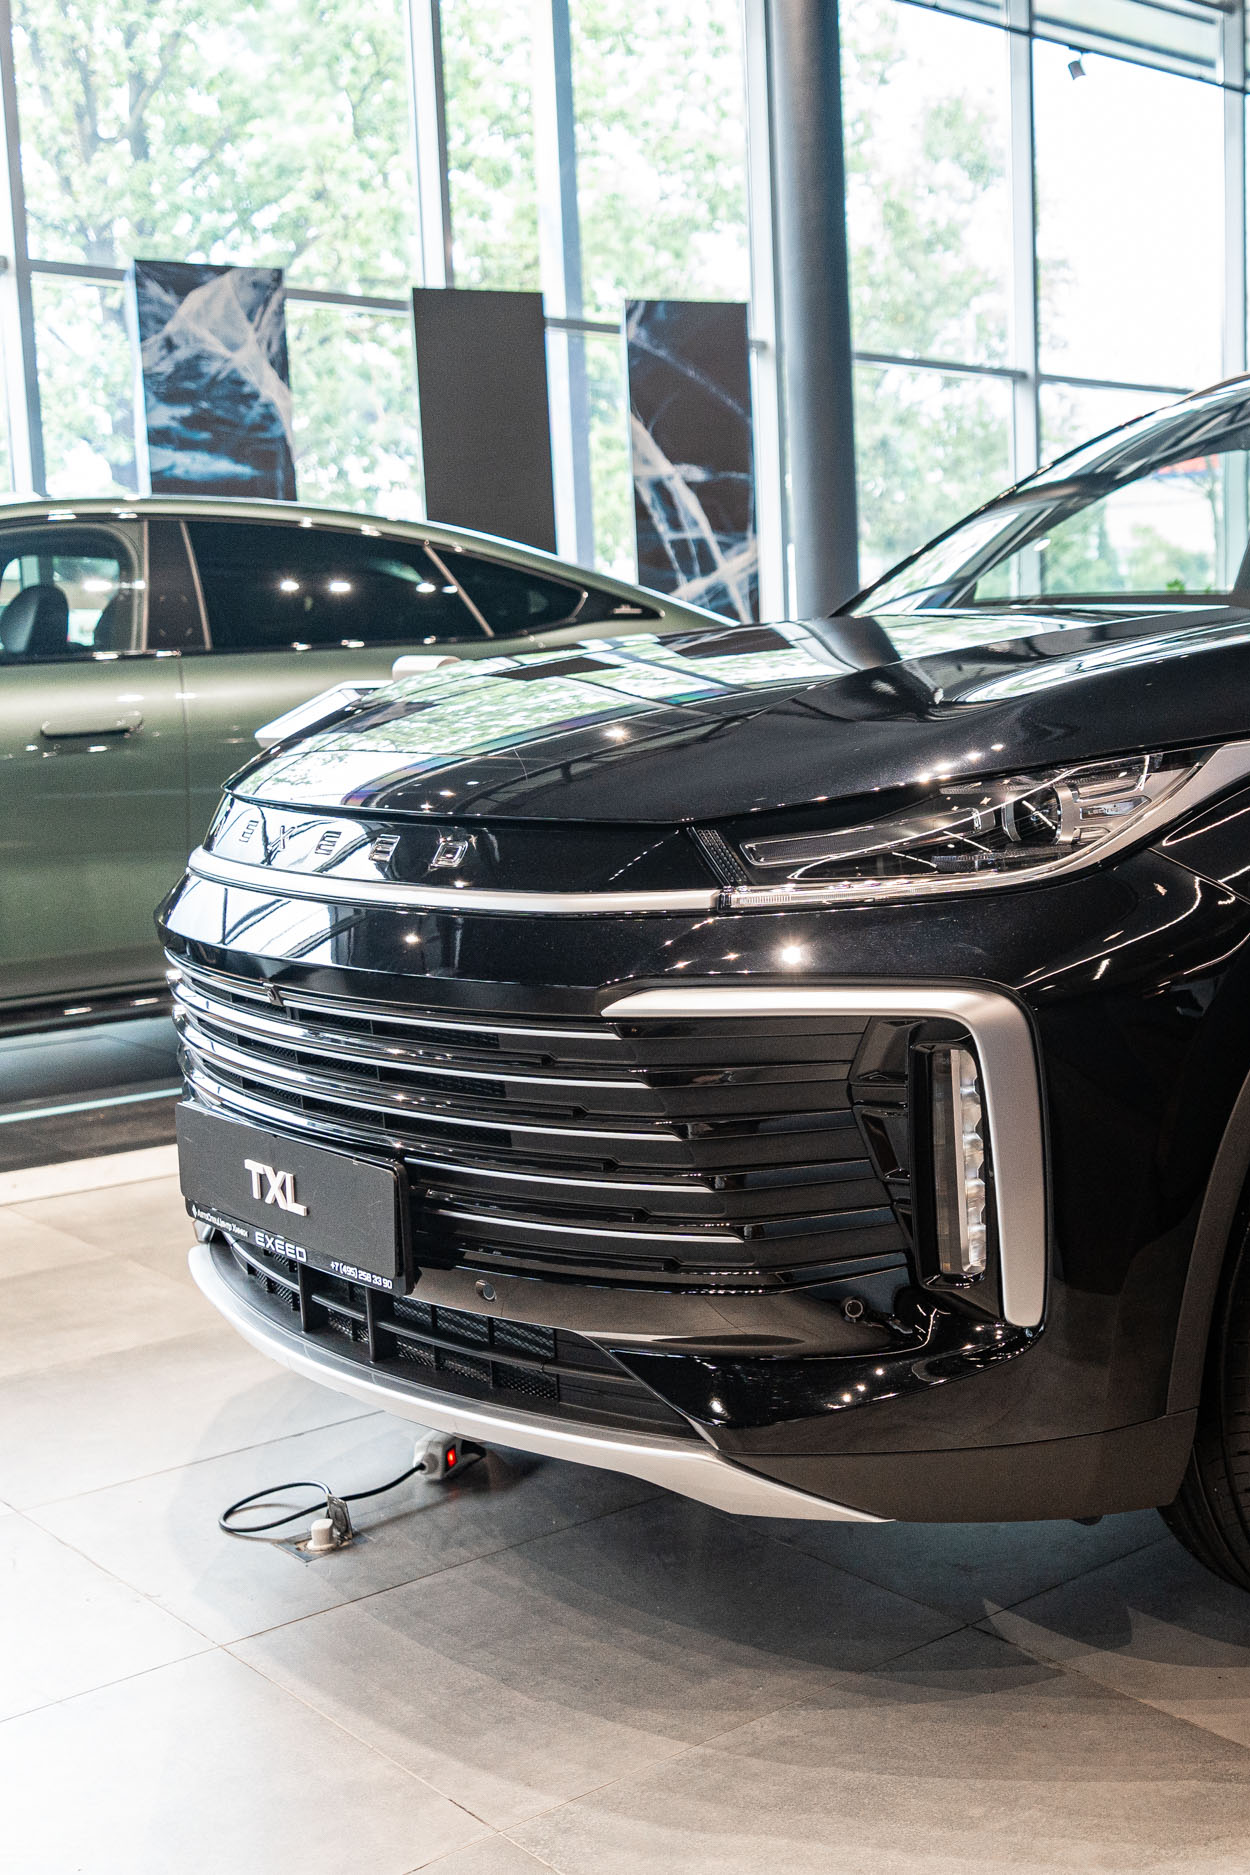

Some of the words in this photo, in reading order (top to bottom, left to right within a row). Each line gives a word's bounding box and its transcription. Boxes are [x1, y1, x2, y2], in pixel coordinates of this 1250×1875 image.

[239, 819, 469, 869] EXEED
[244, 1158, 307, 1217] TXL
[254, 1231, 307, 1263] EXEED
[330, 1261, 339, 1271] +7
[339, 1263, 358, 1279] (495)
[372, 1275, 382, 1286] 33
[382, 1278, 393, 1290] 90
